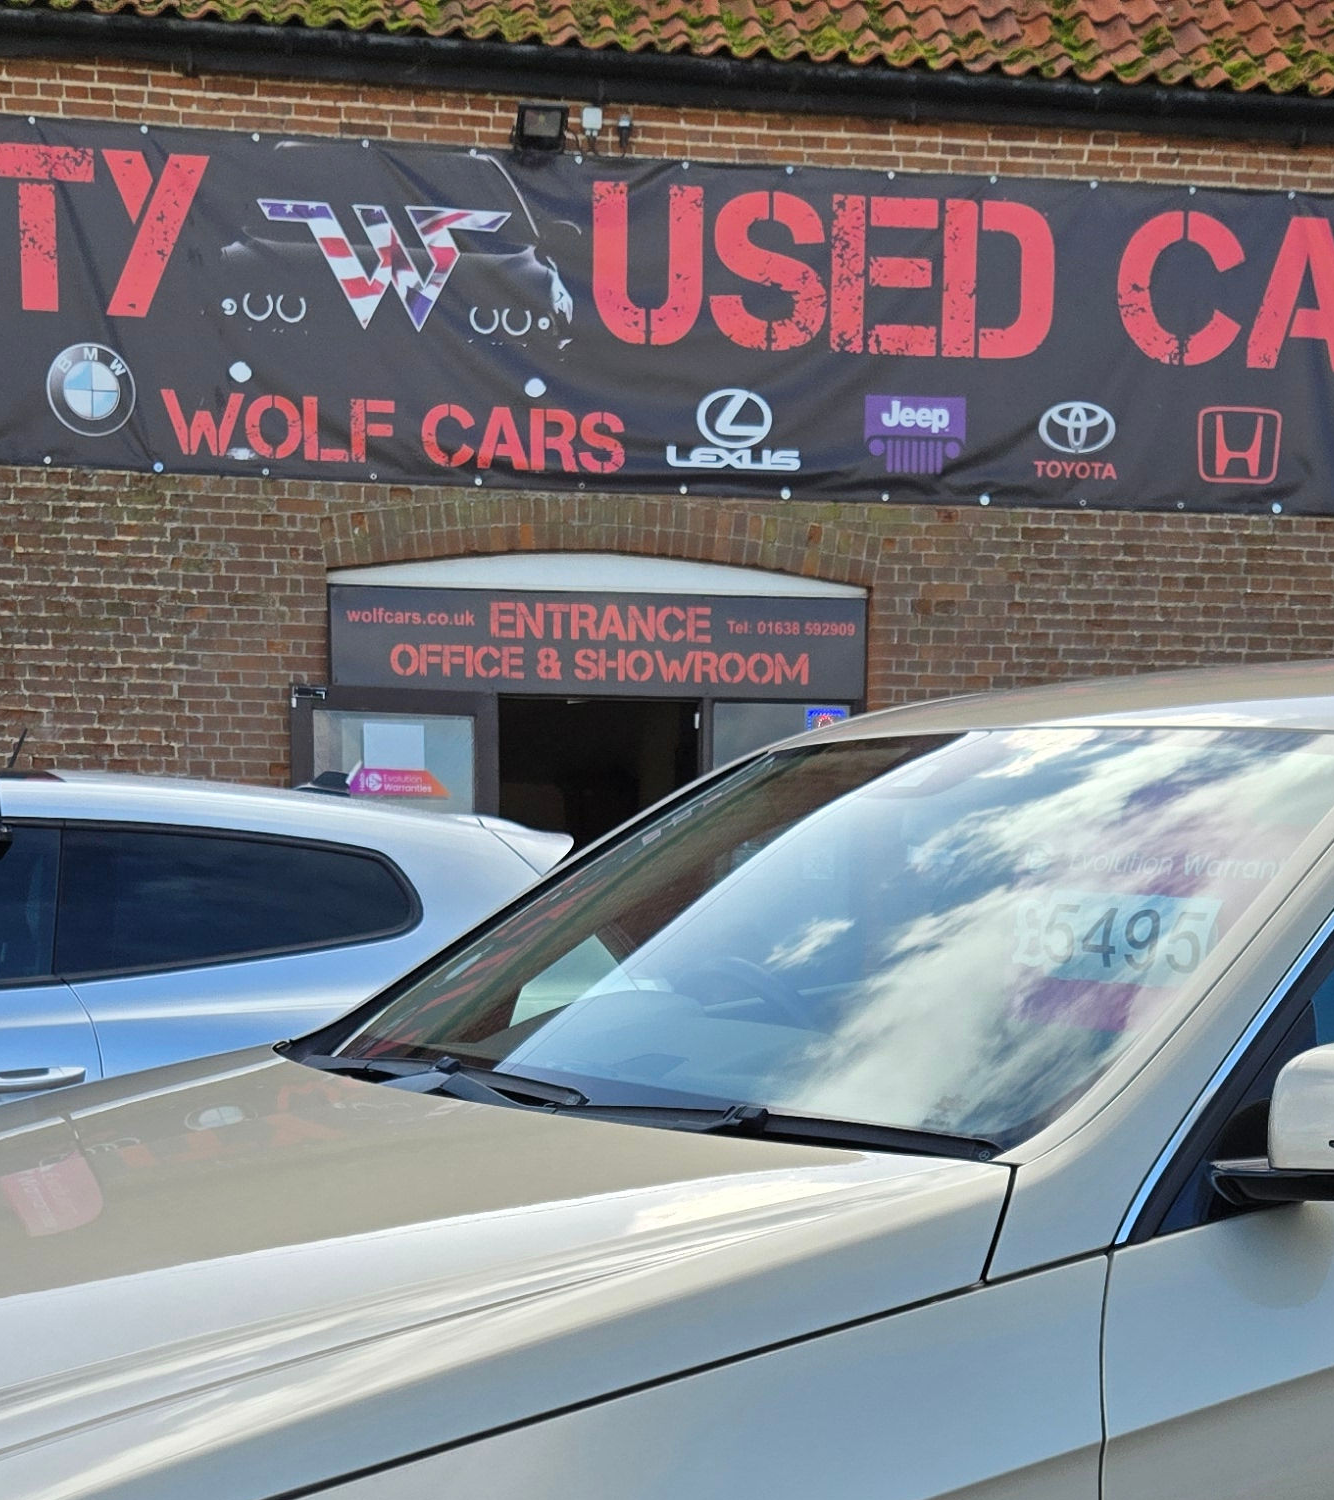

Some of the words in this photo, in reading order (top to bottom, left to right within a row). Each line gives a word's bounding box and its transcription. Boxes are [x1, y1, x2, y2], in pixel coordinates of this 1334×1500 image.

[592, 180, 1055, 360] USED
[162, 389, 395, 465] WOLF
[422, 403, 626, 473] CARS
[881, 401, 950, 434] Jeep
[667, 446, 800, 470] LEXUS
[1034, 459, 1117, 481] TOYOTA
[347, 607, 475, 628] wolfcars.co.uk
[490, 601, 711, 644] ENTRANCE
[727, 619, 753, 636] Tel:
[757, 620, 800, 637] 01638
[805, 621, 855, 638] 592909
[390, 643, 524, 680] OFFICE
[537, 647, 562, 680] &
[574, 648, 809, 686] SHOWROOM
[384, 784, 432, 793] Warranties
